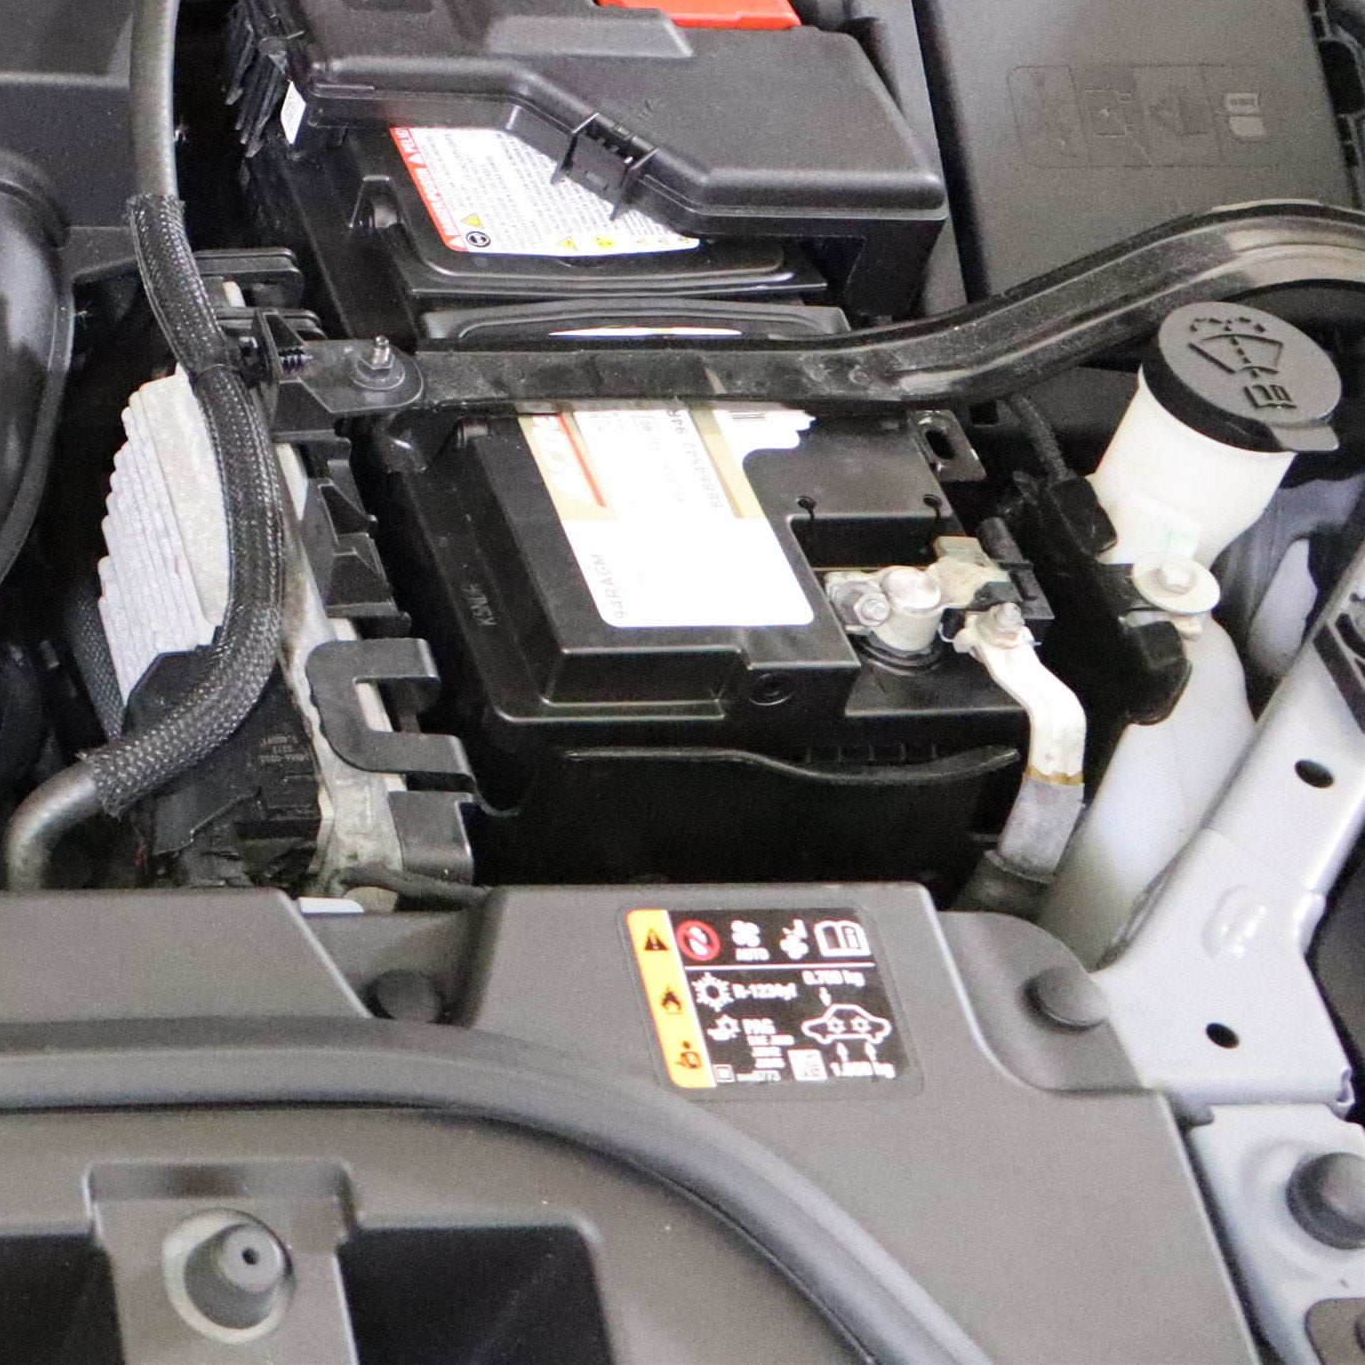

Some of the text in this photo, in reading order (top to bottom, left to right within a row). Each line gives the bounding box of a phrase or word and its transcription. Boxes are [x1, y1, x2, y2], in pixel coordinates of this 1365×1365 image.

[393, 129, 417, 152] PELIG
[682, 442, 723, 510] 88864542
[588, 552, 629, 620] 94RAGM
